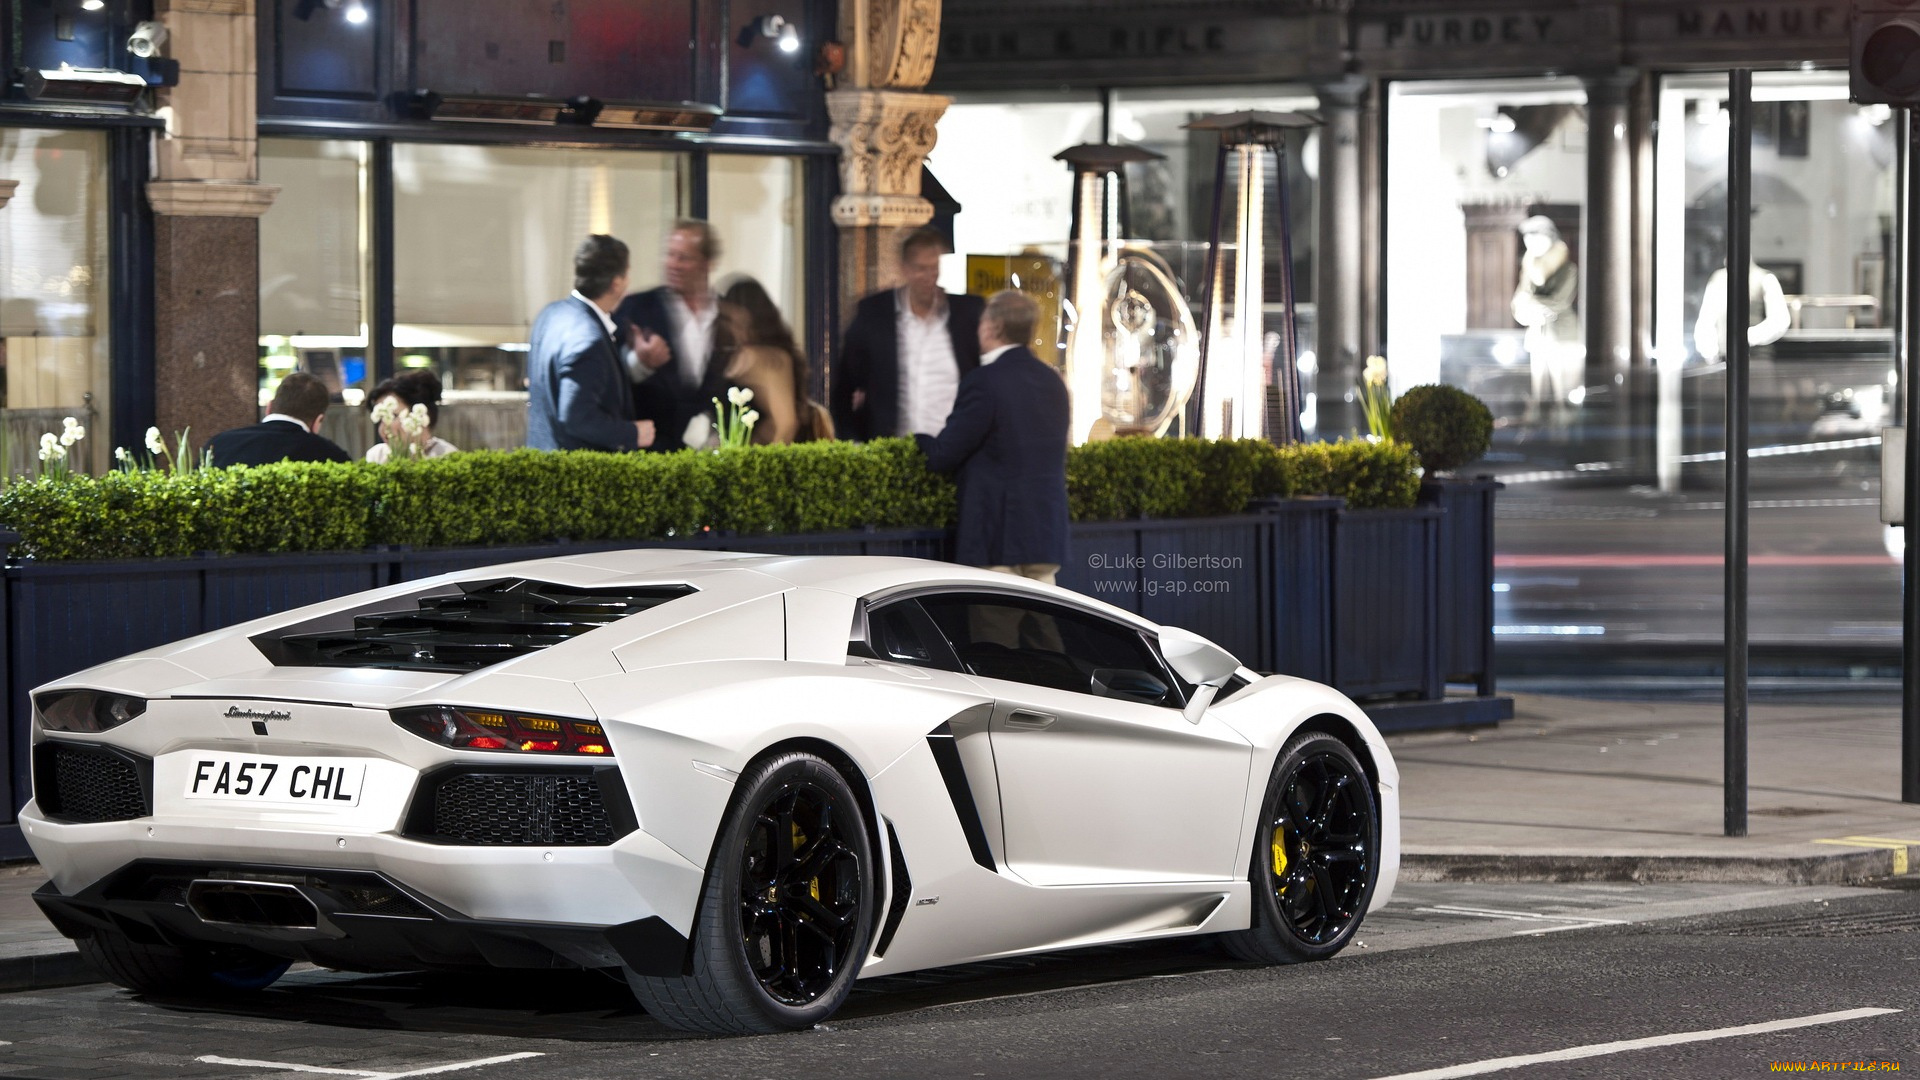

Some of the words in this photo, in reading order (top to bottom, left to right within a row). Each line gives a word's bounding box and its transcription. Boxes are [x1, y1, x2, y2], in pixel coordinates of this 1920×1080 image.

[1384, 14, 1553, 46] PURDEY
[1677, 7, 1850, 35] MANUF
[945, 29, 1019, 56] GUN
[1109, 25, 1225, 53] RIFLE
[192, 760, 279, 796] FA57
[289, 765, 352, 801] CHL
